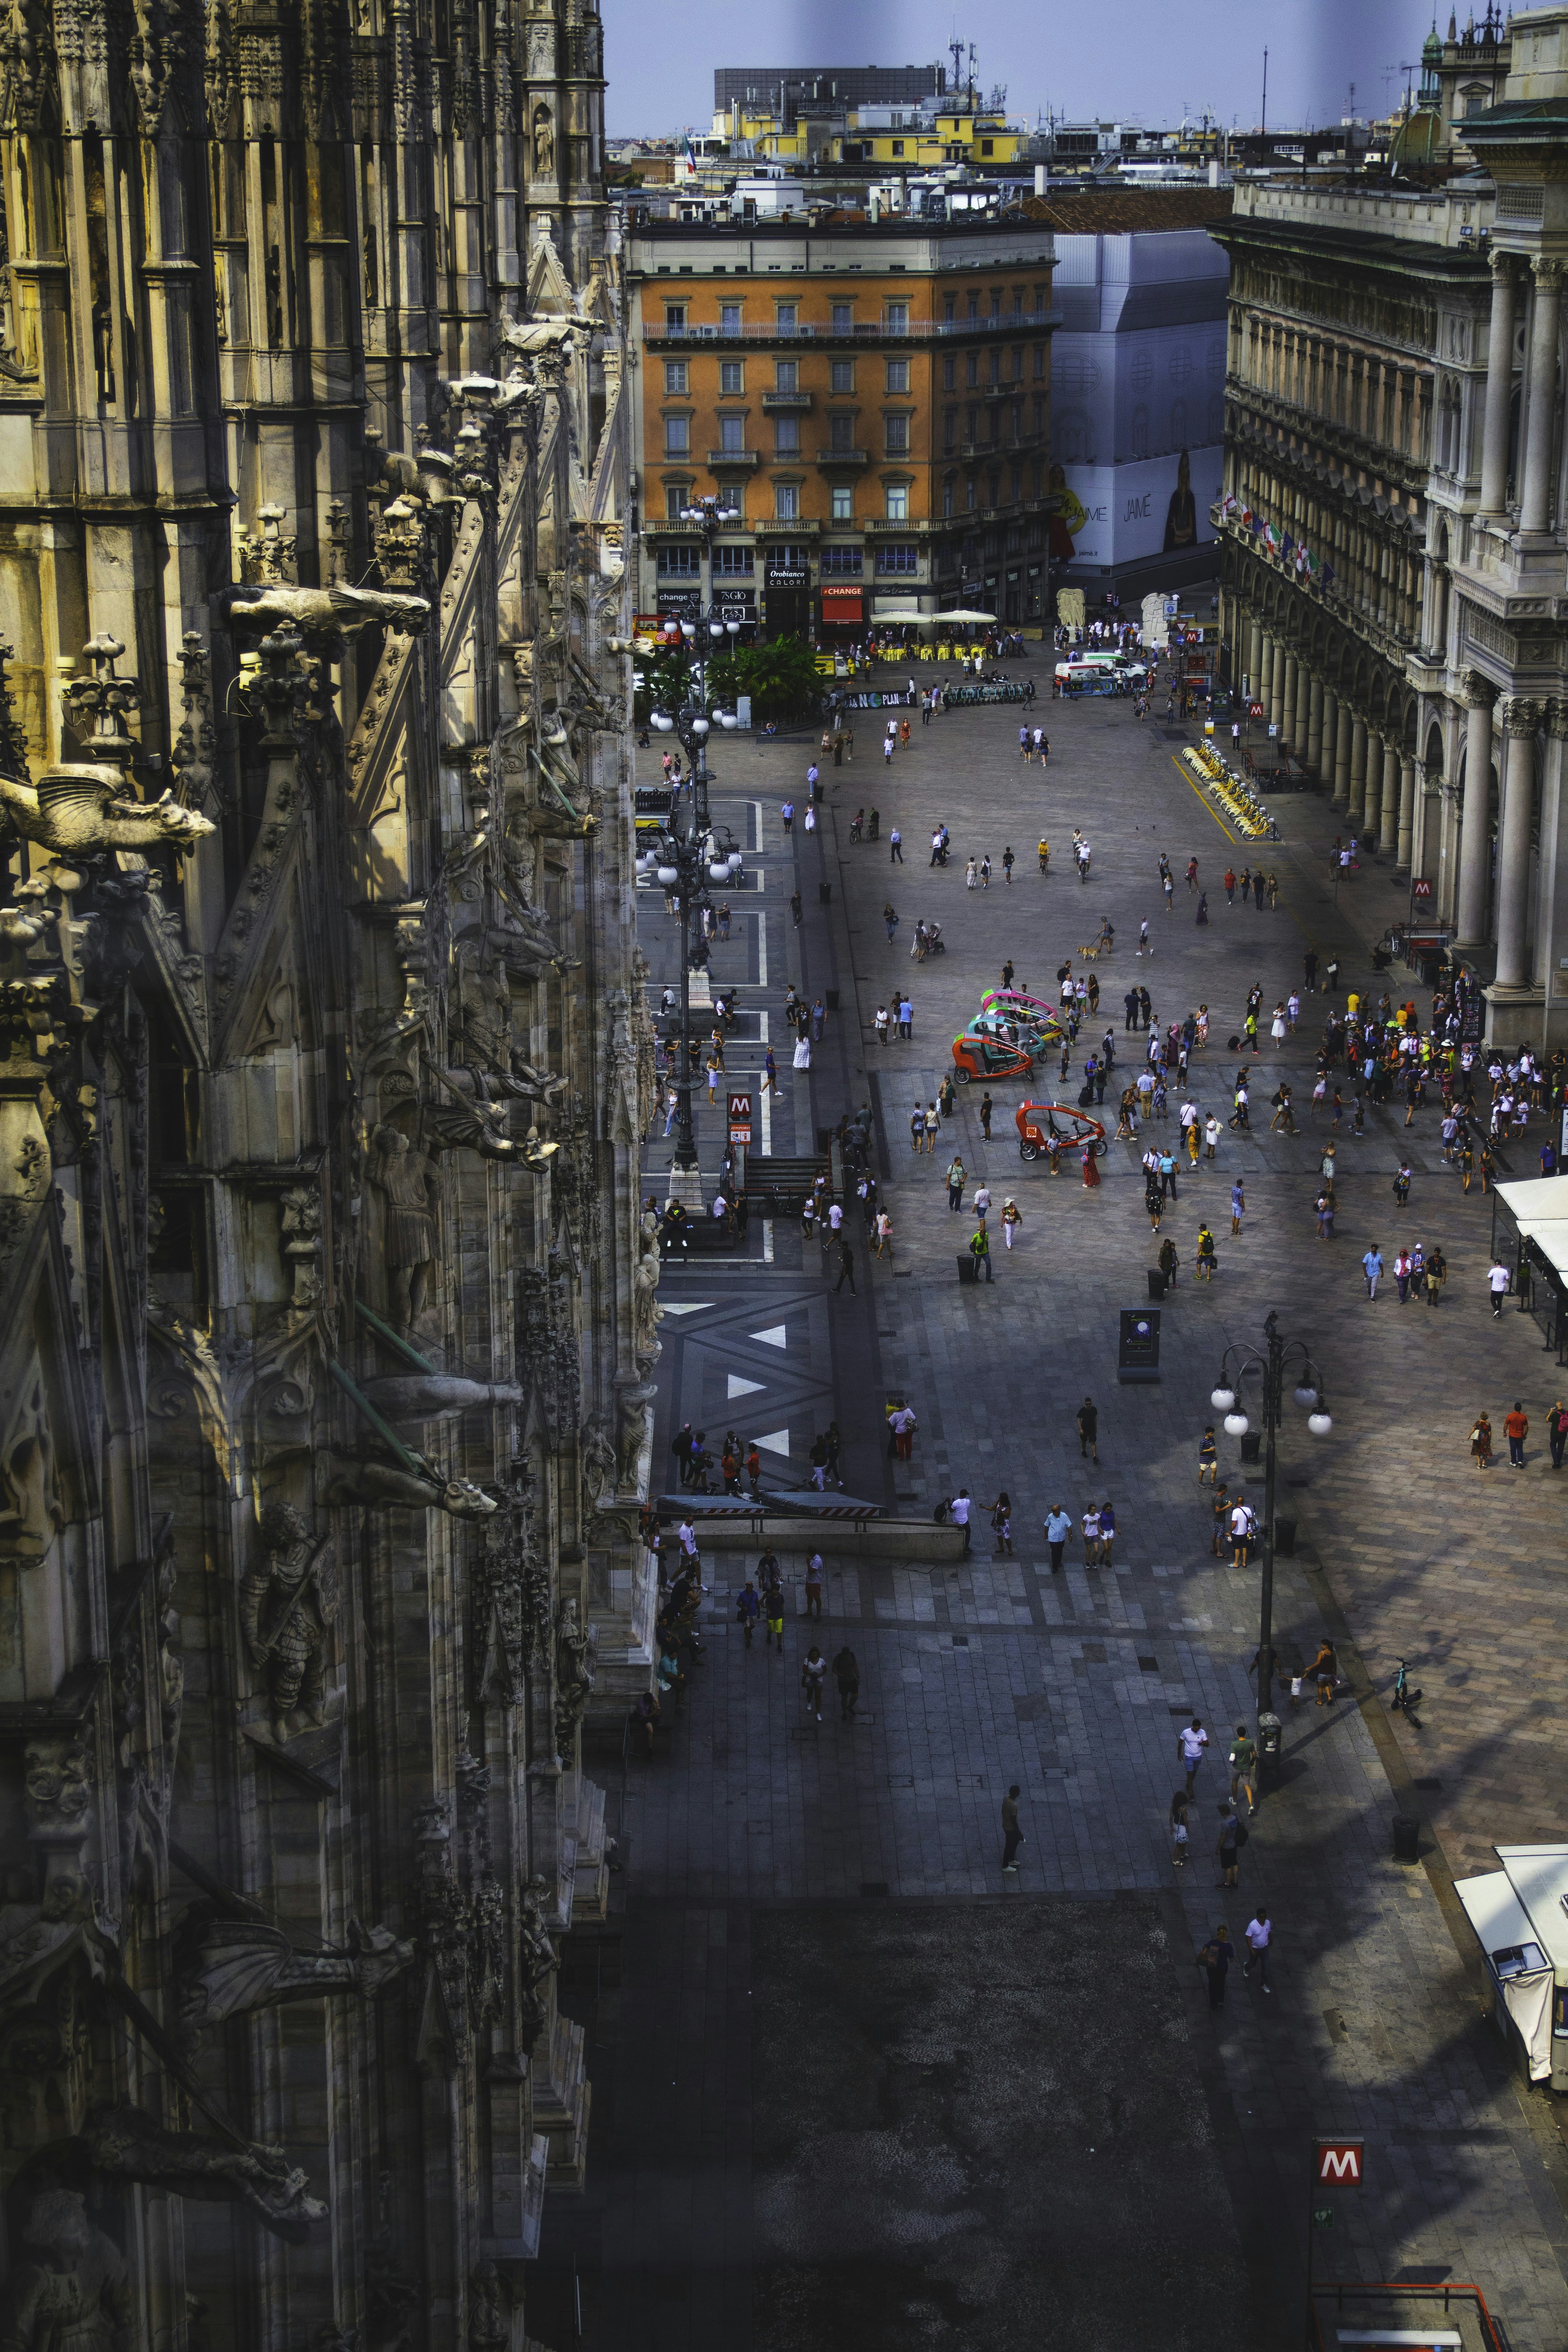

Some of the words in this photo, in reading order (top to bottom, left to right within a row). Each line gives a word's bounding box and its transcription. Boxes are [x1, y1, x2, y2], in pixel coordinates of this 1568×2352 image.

[659, 593, 688, 602] change
[1250, 706, 1262, 715] M
[1415, 883, 1430, 894] M
[731, 1098, 750, 1112] M
[1321, 2151, 1359, 2177] M
